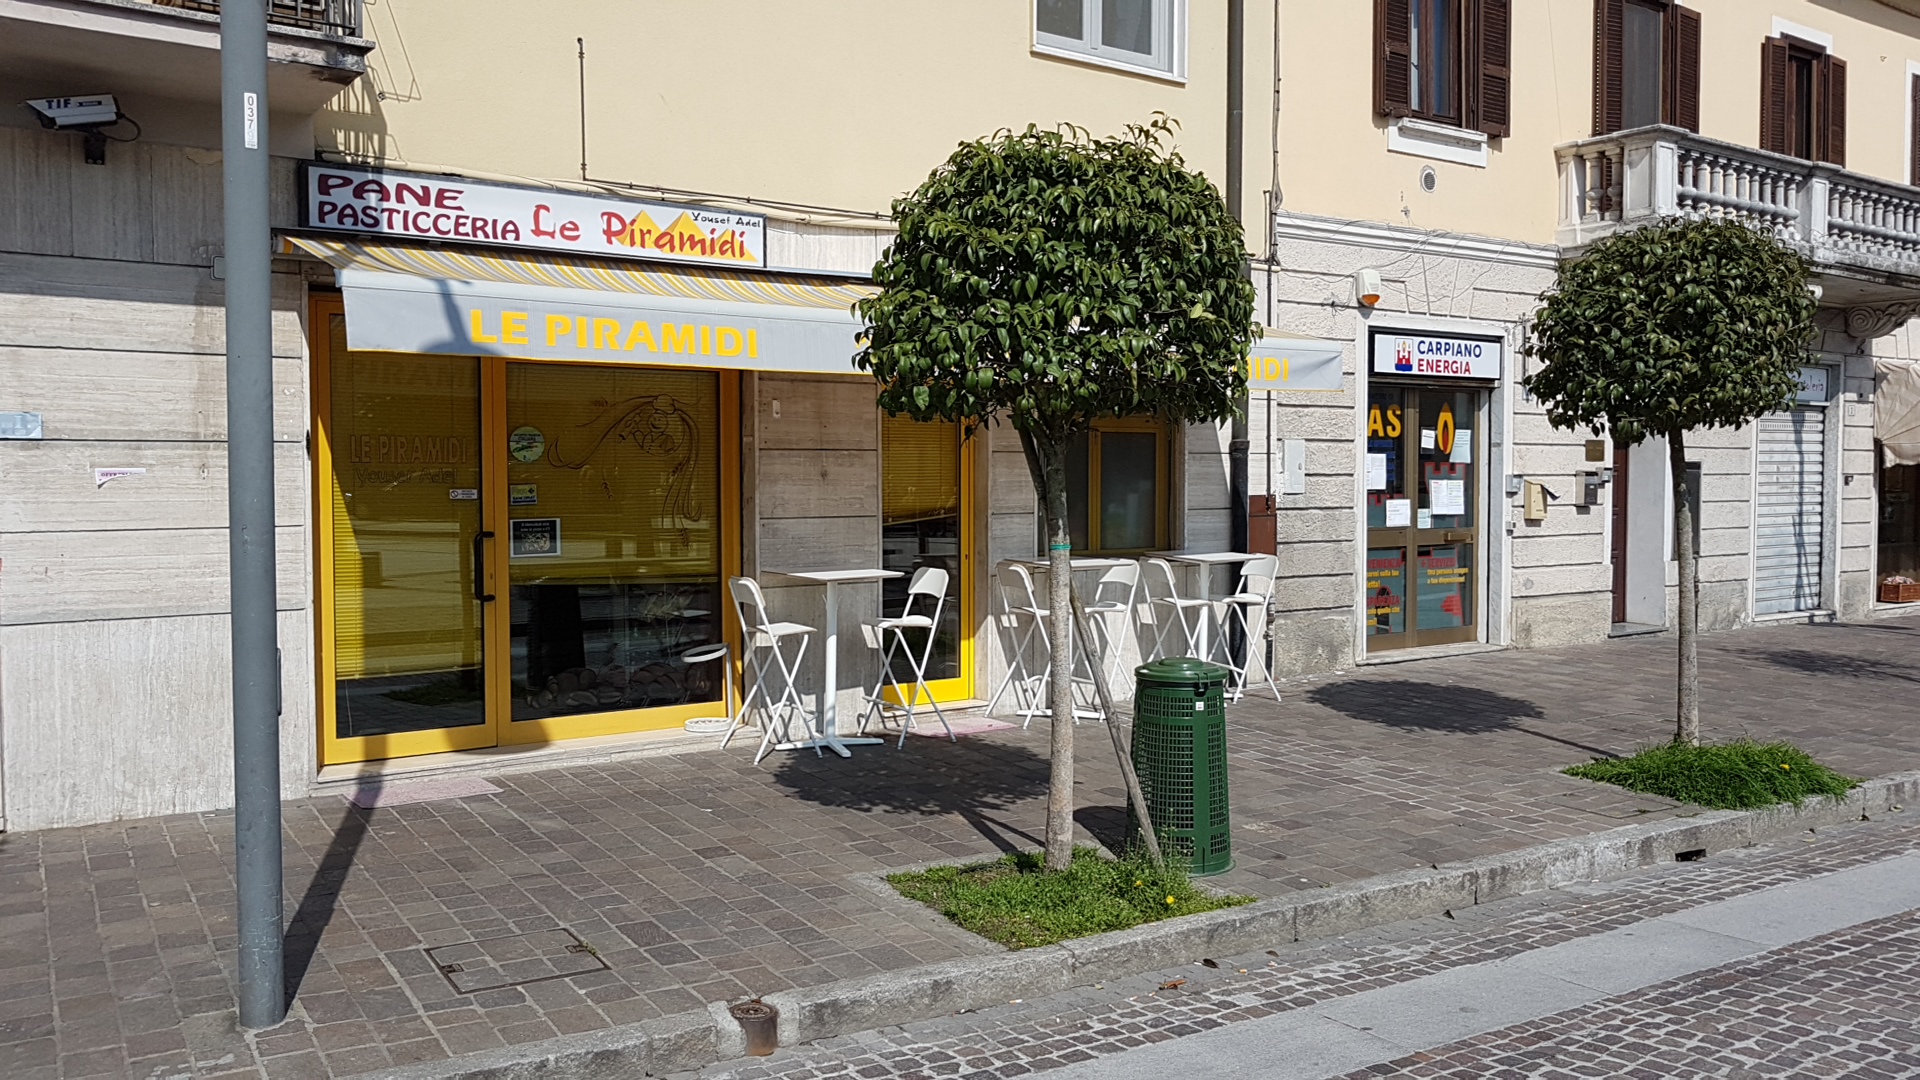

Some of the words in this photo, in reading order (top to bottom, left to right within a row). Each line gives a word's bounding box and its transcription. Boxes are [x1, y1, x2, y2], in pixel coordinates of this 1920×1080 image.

[45, 98, 71, 109] TIF
[318, 173, 465, 212] PANE
[318, 200, 521, 242] PASTICCERIA
[530, 204, 581, 242] Le
[600, 211, 747, 258] Piramidi
[691, 211, 730, 225] Yousef
[735, 216, 761, 228] Adel
[470, 309, 529, 345] LE
[545, 314, 758, 358] PIRAMIDI
[1417, 340, 1482, 358] CARPIANO
[1417, 358, 1472, 375] ENERGIA
[351, 435, 372, 463] LE
[378, 435, 467, 464] PIRAMIDI
